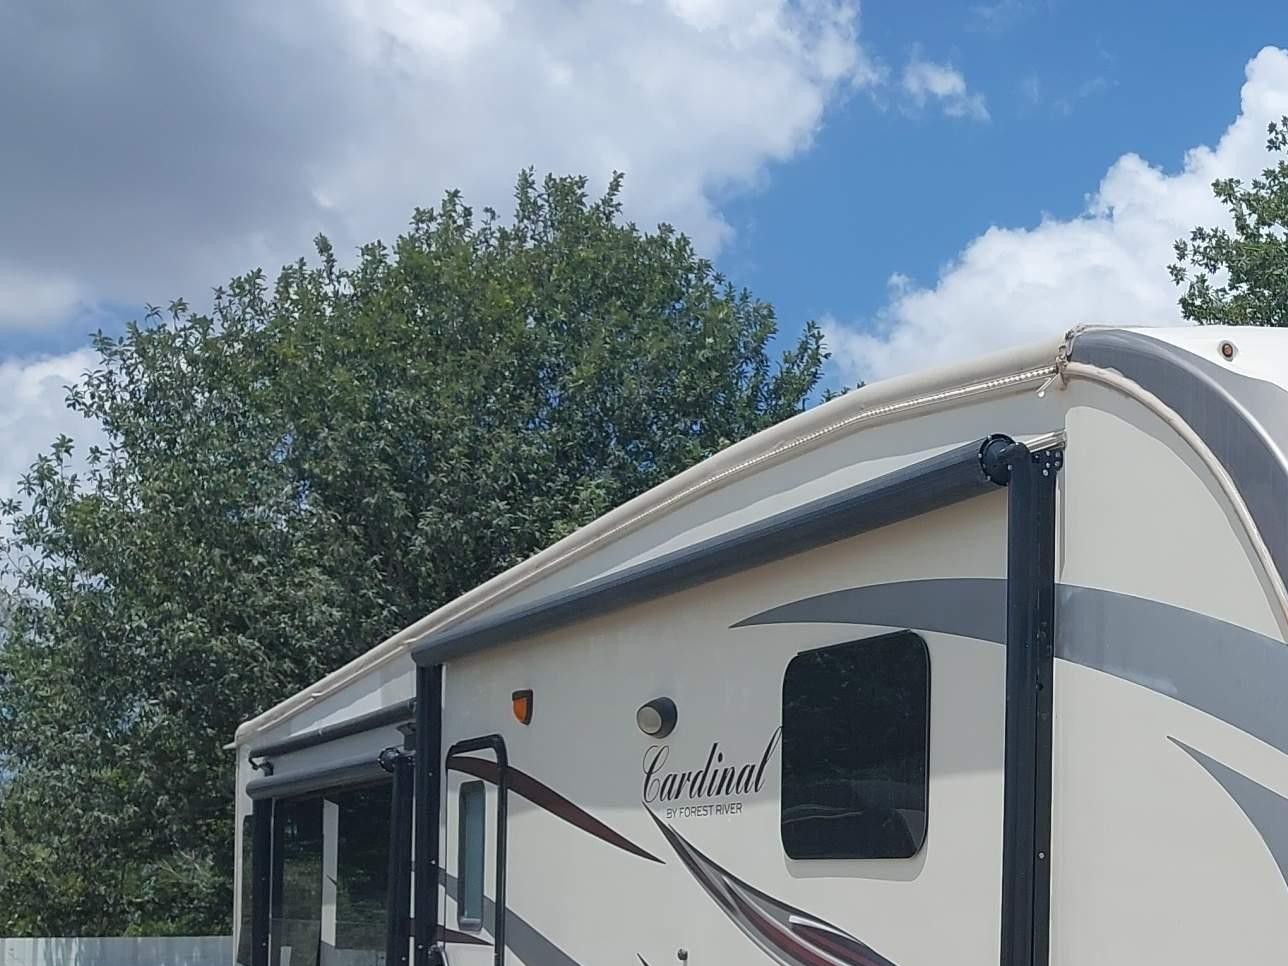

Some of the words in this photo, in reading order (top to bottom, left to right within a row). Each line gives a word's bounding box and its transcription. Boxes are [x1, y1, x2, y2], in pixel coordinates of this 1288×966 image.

[642, 725, 783, 804] Cardinal
[666, 808, 677, 819] BY
[679, 805, 714, 818] FOREST
[715, 802, 742, 815] RIVER
